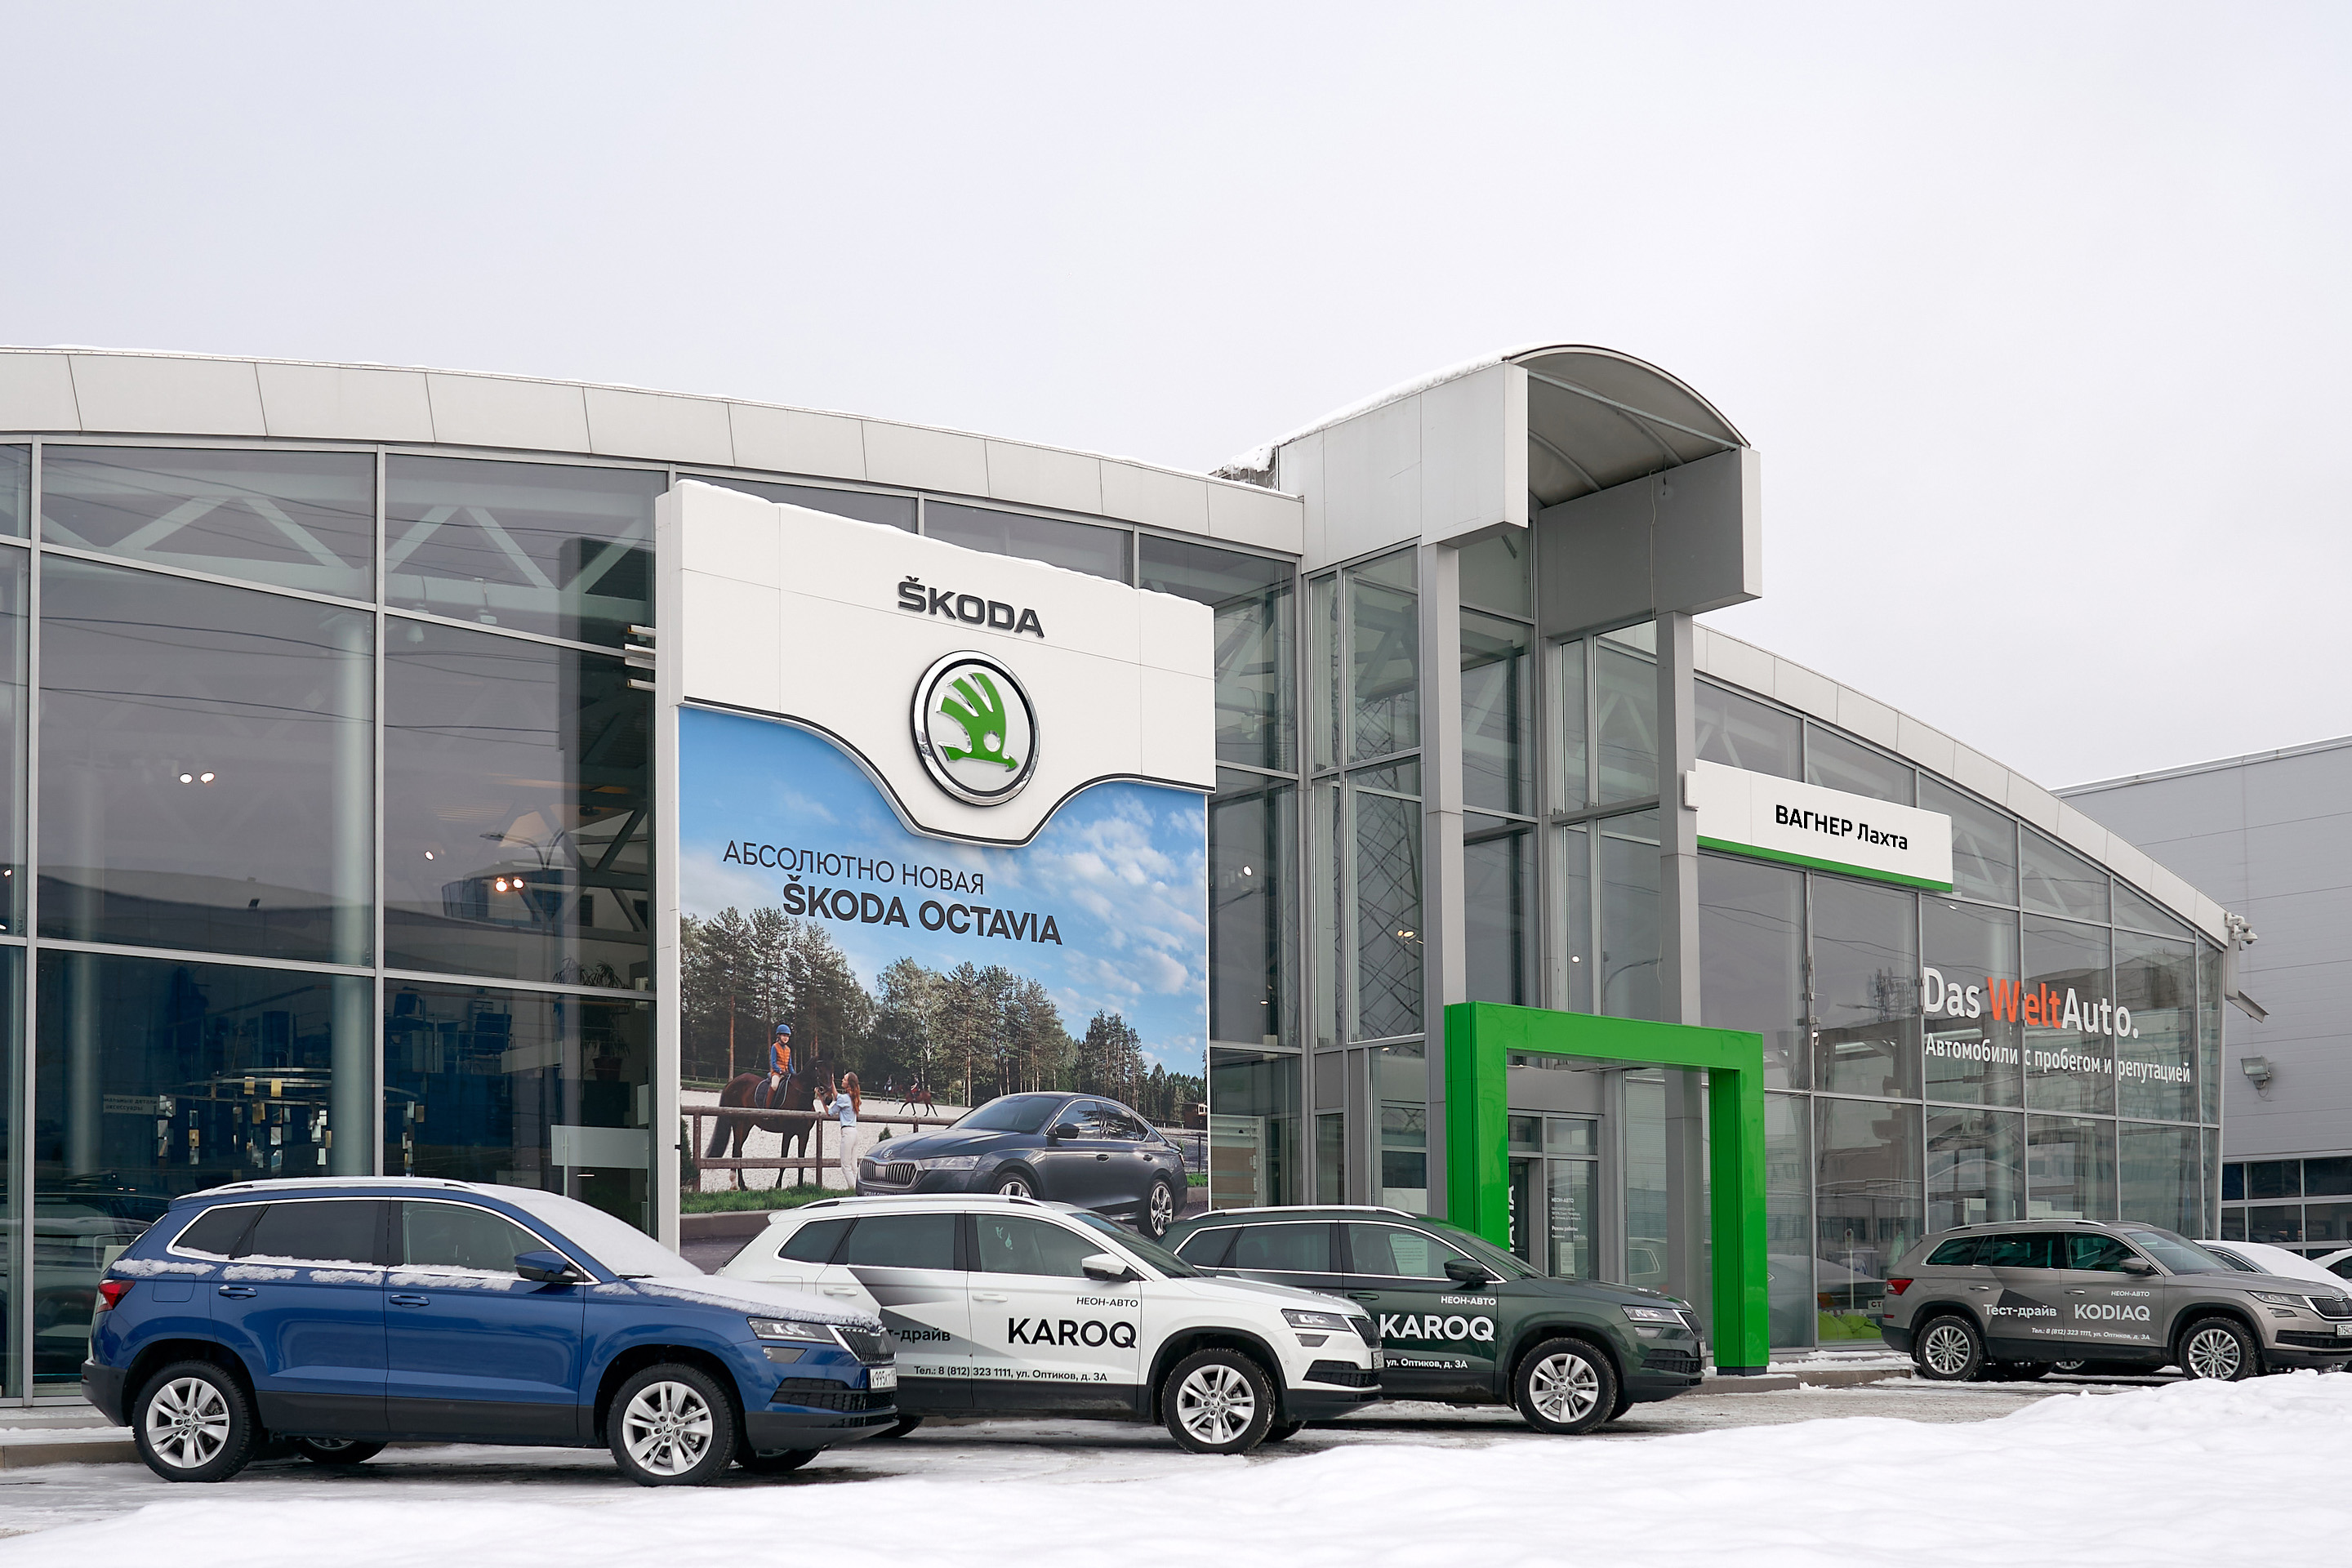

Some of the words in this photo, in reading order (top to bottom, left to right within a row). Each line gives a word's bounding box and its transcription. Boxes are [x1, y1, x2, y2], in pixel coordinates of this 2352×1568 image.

[898, 575, 1045, 639] ŠKODA
[1775, 804, 1853, 837] ВАГНЕР
[1857, 822, 1908, 850] Лахта
[723, 840, 894, 883] АБСОЛЮТНО
[902, 863, 984, 895] НОВАЯ
[782, 874, 910, 928] ŠKODA
[918, 900, 1062, 946] OCTAVIA
[1923, 966, 1980, 1018] Das
[1925, 1032, 2018, 1065] Автомобили
[2025, 1050, 2031, 1066] с
[2034, 1048, 2100, 1075] пробегом
[2104, 1060, 2112, 1075] и
[2118, 1062, 2190, 1083] репутацией
[1076, 1296, 1138, 1307] НЕОН-АВТО
[1441, 1295, 1497, 1306] НЕОН-АВТО
[1983, 1303, 2057, 1319] Тест-драйв
[2074, 1303, 2151, 1321] KODIAQ
[1008, 1317, 1137, 1349] KAROQ
[1379, 1313, 1495, 1342] KAROQ
[2051, 1328, 2066, 1336] (812)
[914, 1365, 937, 1375] Тел.:
[938, 1365, 945, 1375] 8
[947, 1365, 970, 1377] (812)
[973, 1367, 991, 1377] 323
[993, 1368, 1013, 1379] 1111,
[1015, 1370, 1030, 1379] ул.
[1032, 1370, 1079, 1381] Оптиков,
[1080, 1373, 1091, 1382] д.
[1386, 1359, 1399, 1369] ул.
[1401, 1358, 1442, 1370] Оптиков,
[1443, 1361, 1453, 1370] д.
